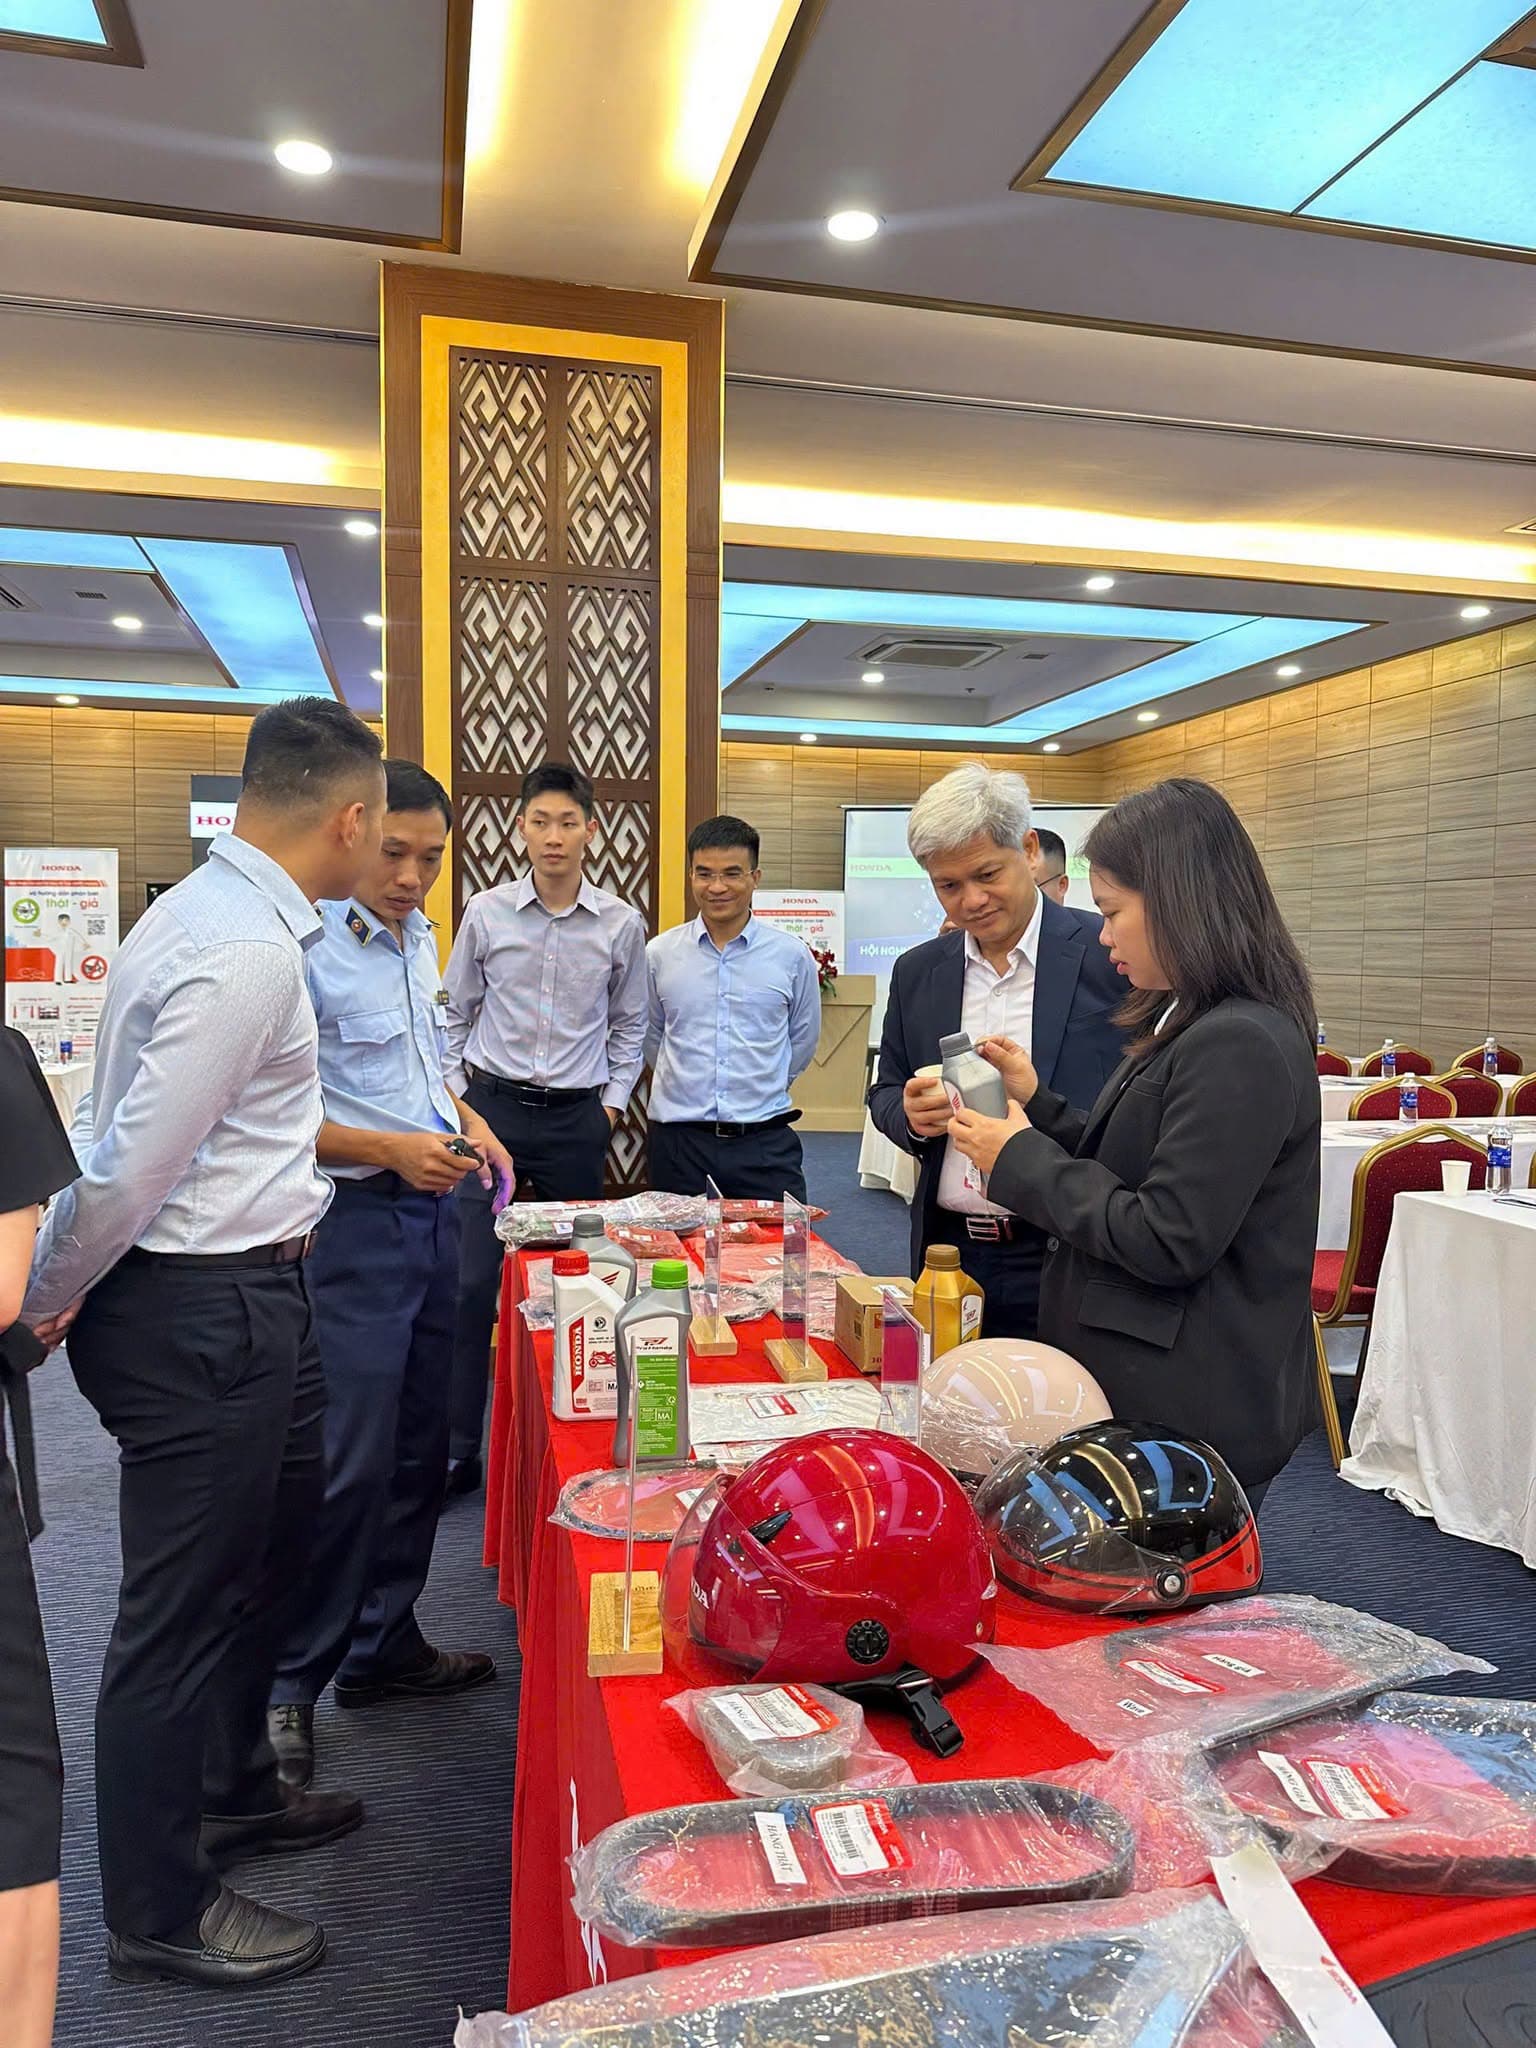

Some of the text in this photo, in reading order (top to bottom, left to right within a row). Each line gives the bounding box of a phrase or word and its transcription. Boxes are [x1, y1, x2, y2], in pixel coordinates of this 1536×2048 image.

[196, 816, 232, 826] HO
[850, 864, 892, 872] HONDA
[881, 946, 908, 956] NGH
[658, 1411, 670, 1421] MA
[691, 1575, 710, 1610] DA
